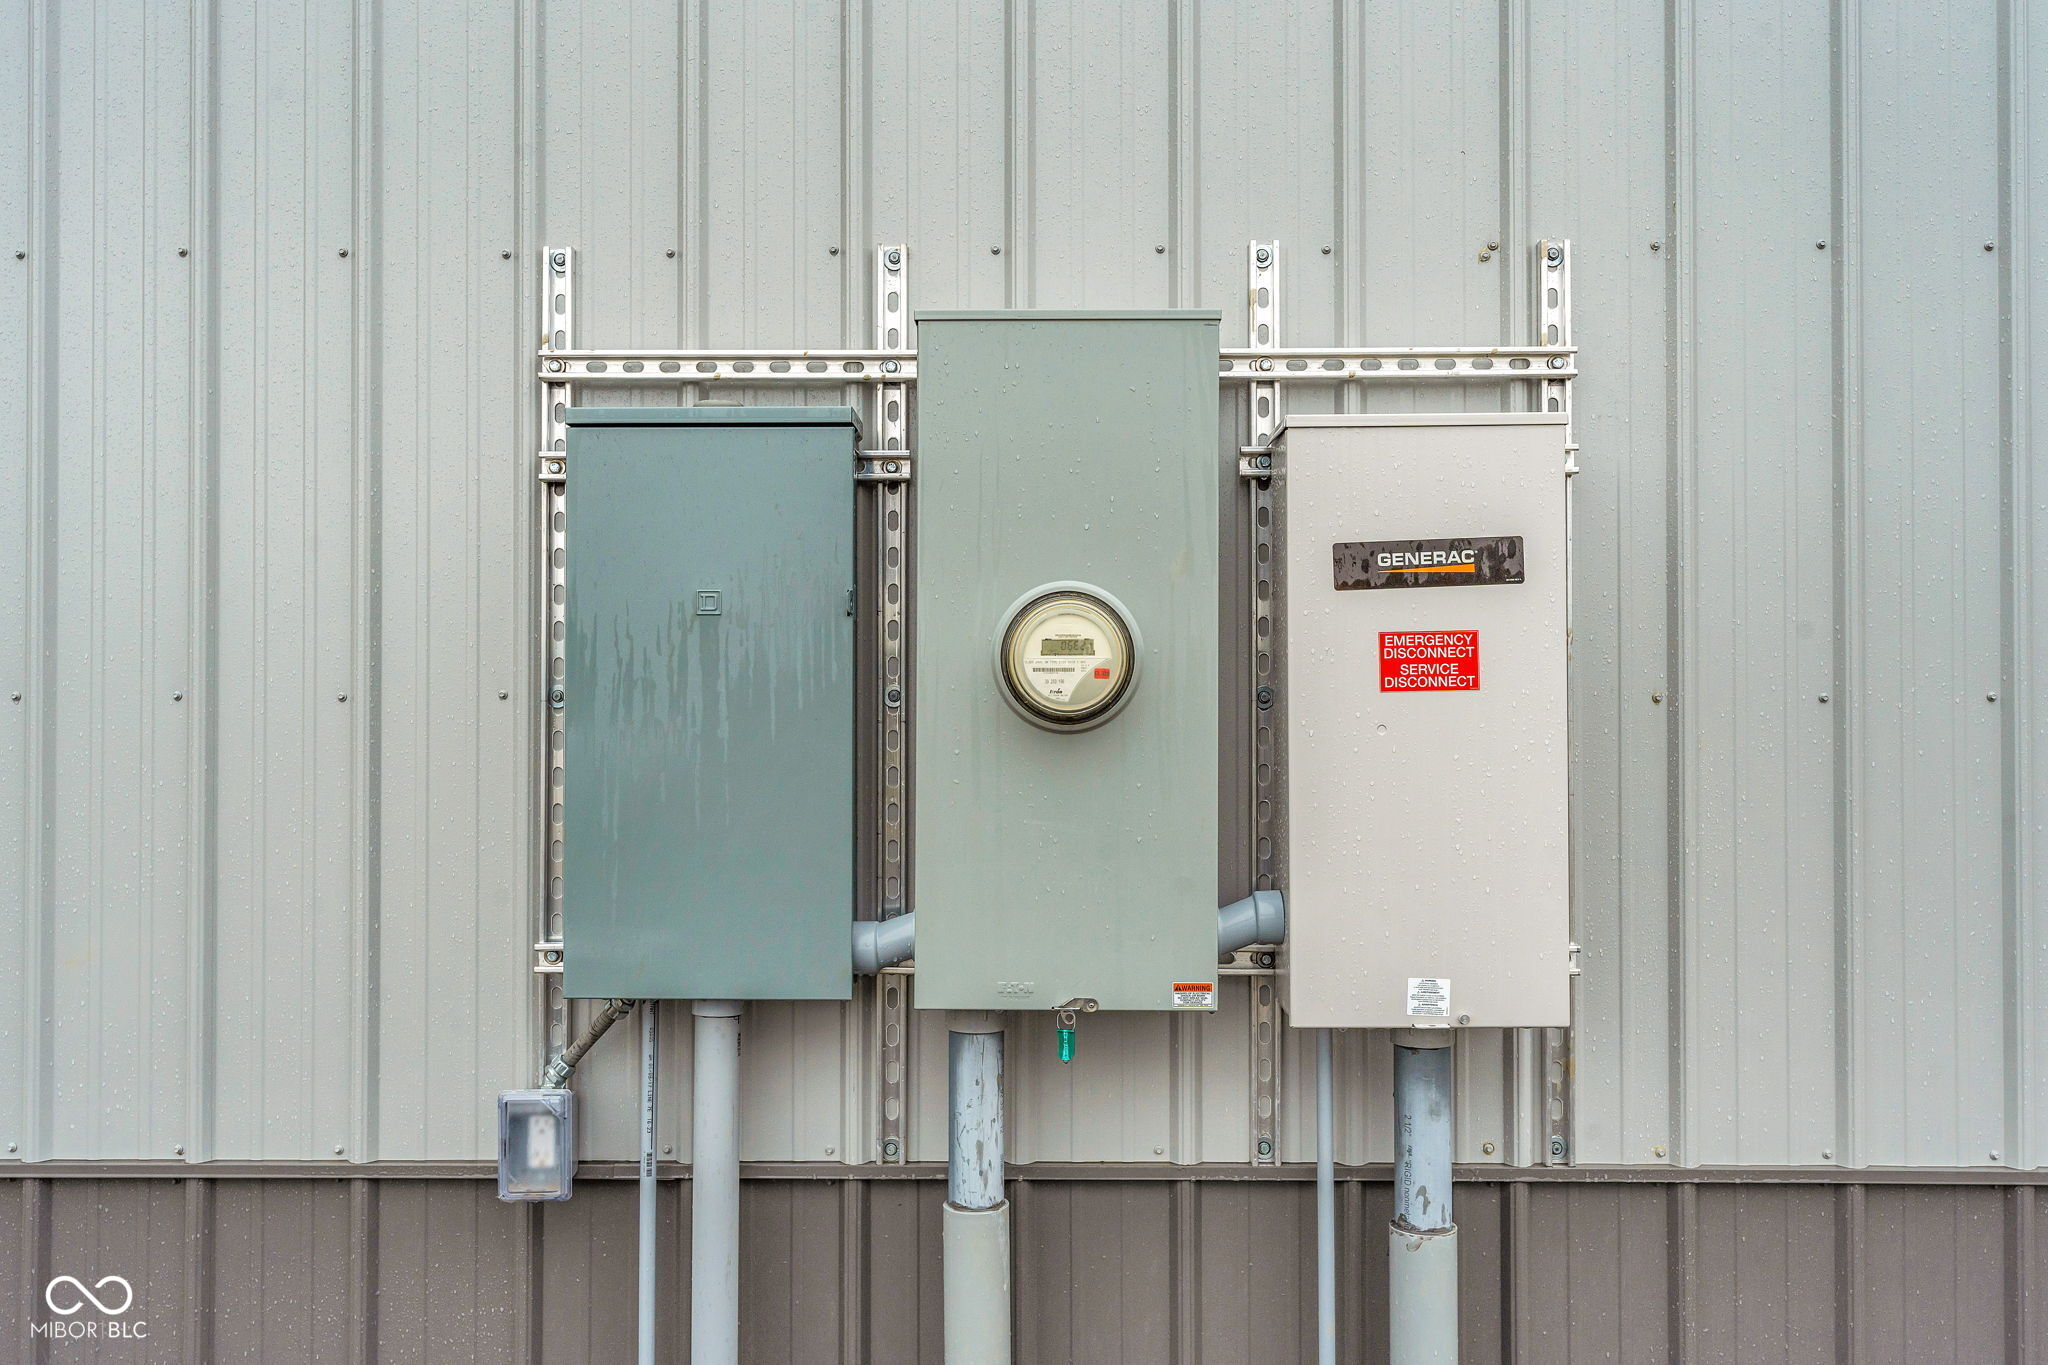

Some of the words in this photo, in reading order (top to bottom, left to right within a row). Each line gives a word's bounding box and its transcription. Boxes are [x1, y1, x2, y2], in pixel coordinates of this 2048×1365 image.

[1377, 549, 1475, 566] GENERAC
[1384, 633, 1473, 647] EMERGENCY
[1383, 646, 1474, 659] DISCONNECT
[1399, 663, 1459, 675] SERVICE
[1384, 675, 1476, 688] DISCONNECT
